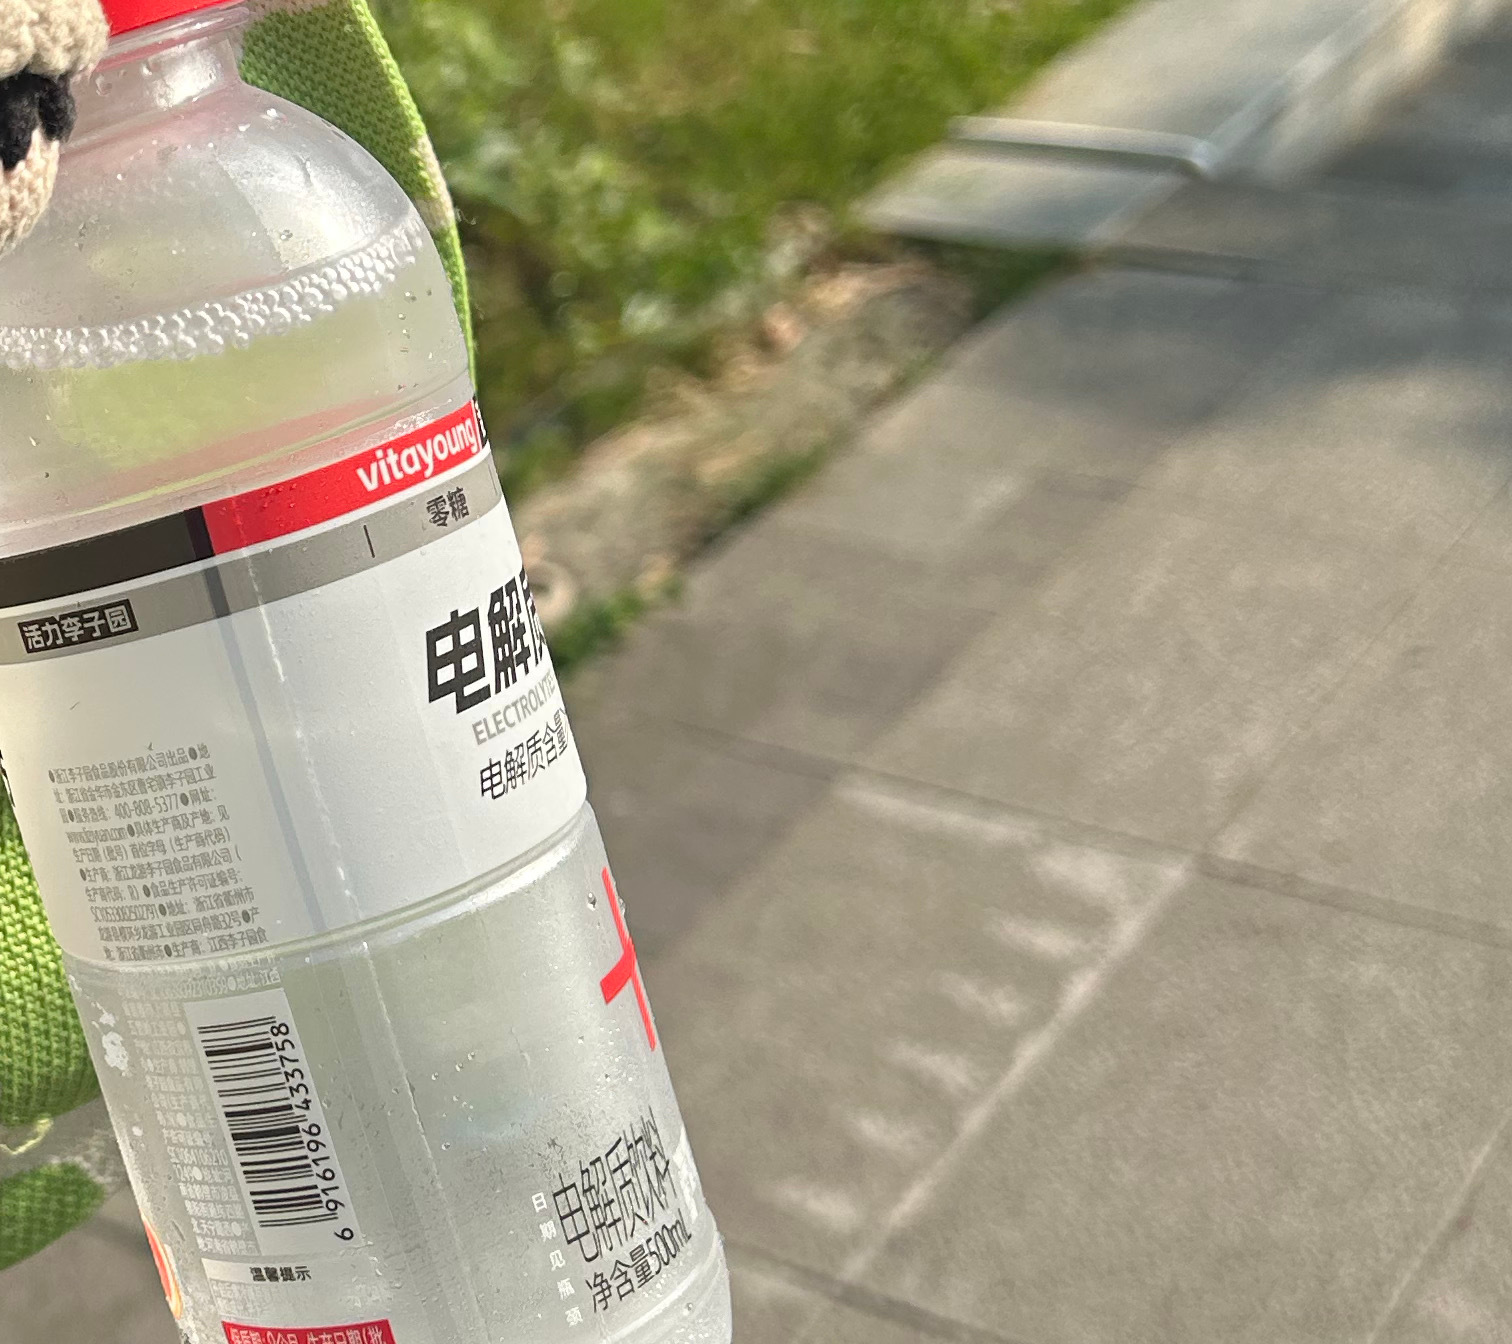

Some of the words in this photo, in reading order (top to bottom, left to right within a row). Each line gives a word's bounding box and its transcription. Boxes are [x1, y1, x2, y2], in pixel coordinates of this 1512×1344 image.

[356, 418, 478, 492] vitayoung
[426, 486, 470, 527] 零糖
[22, 605, 133, 650] 活力李子园
[270, 1022, 312, 1112] 433758
[301, 1122, 346, 1213] 916196
[551, 1104, 678, 1263] 电解质饮料
[249, 1265, 312, 1282] 温馨提示
[585, 1207, 692, 1313] 净含量500mL
